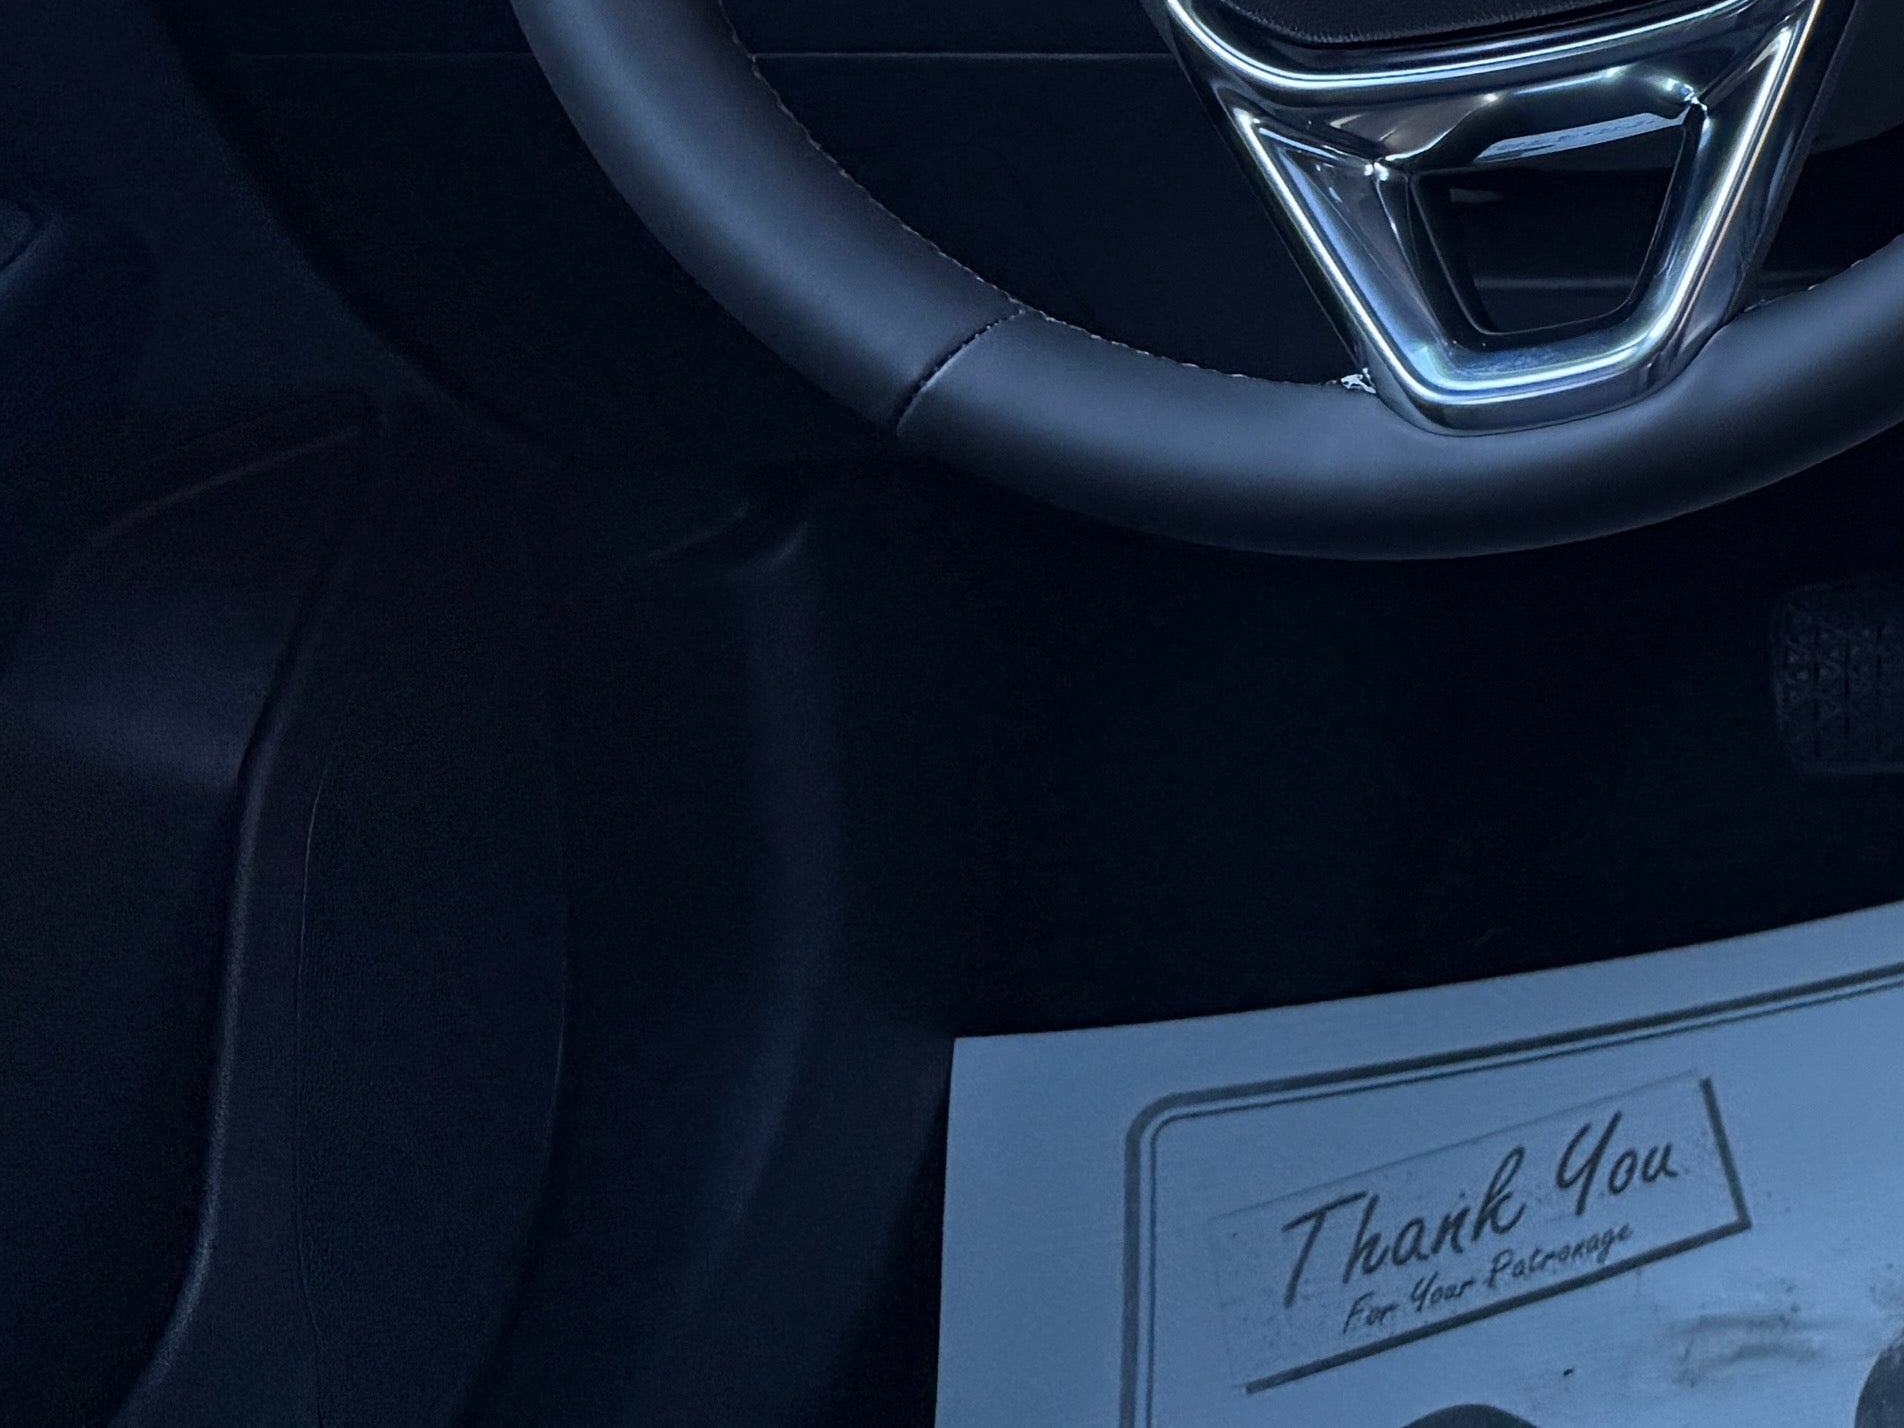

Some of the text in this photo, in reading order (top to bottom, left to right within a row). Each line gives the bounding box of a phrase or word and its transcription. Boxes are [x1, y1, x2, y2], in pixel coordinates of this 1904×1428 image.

[1281, 1110, 1677, 1308] Thank You
[1342, 1223, 1632, 1334] For Your Patronage
